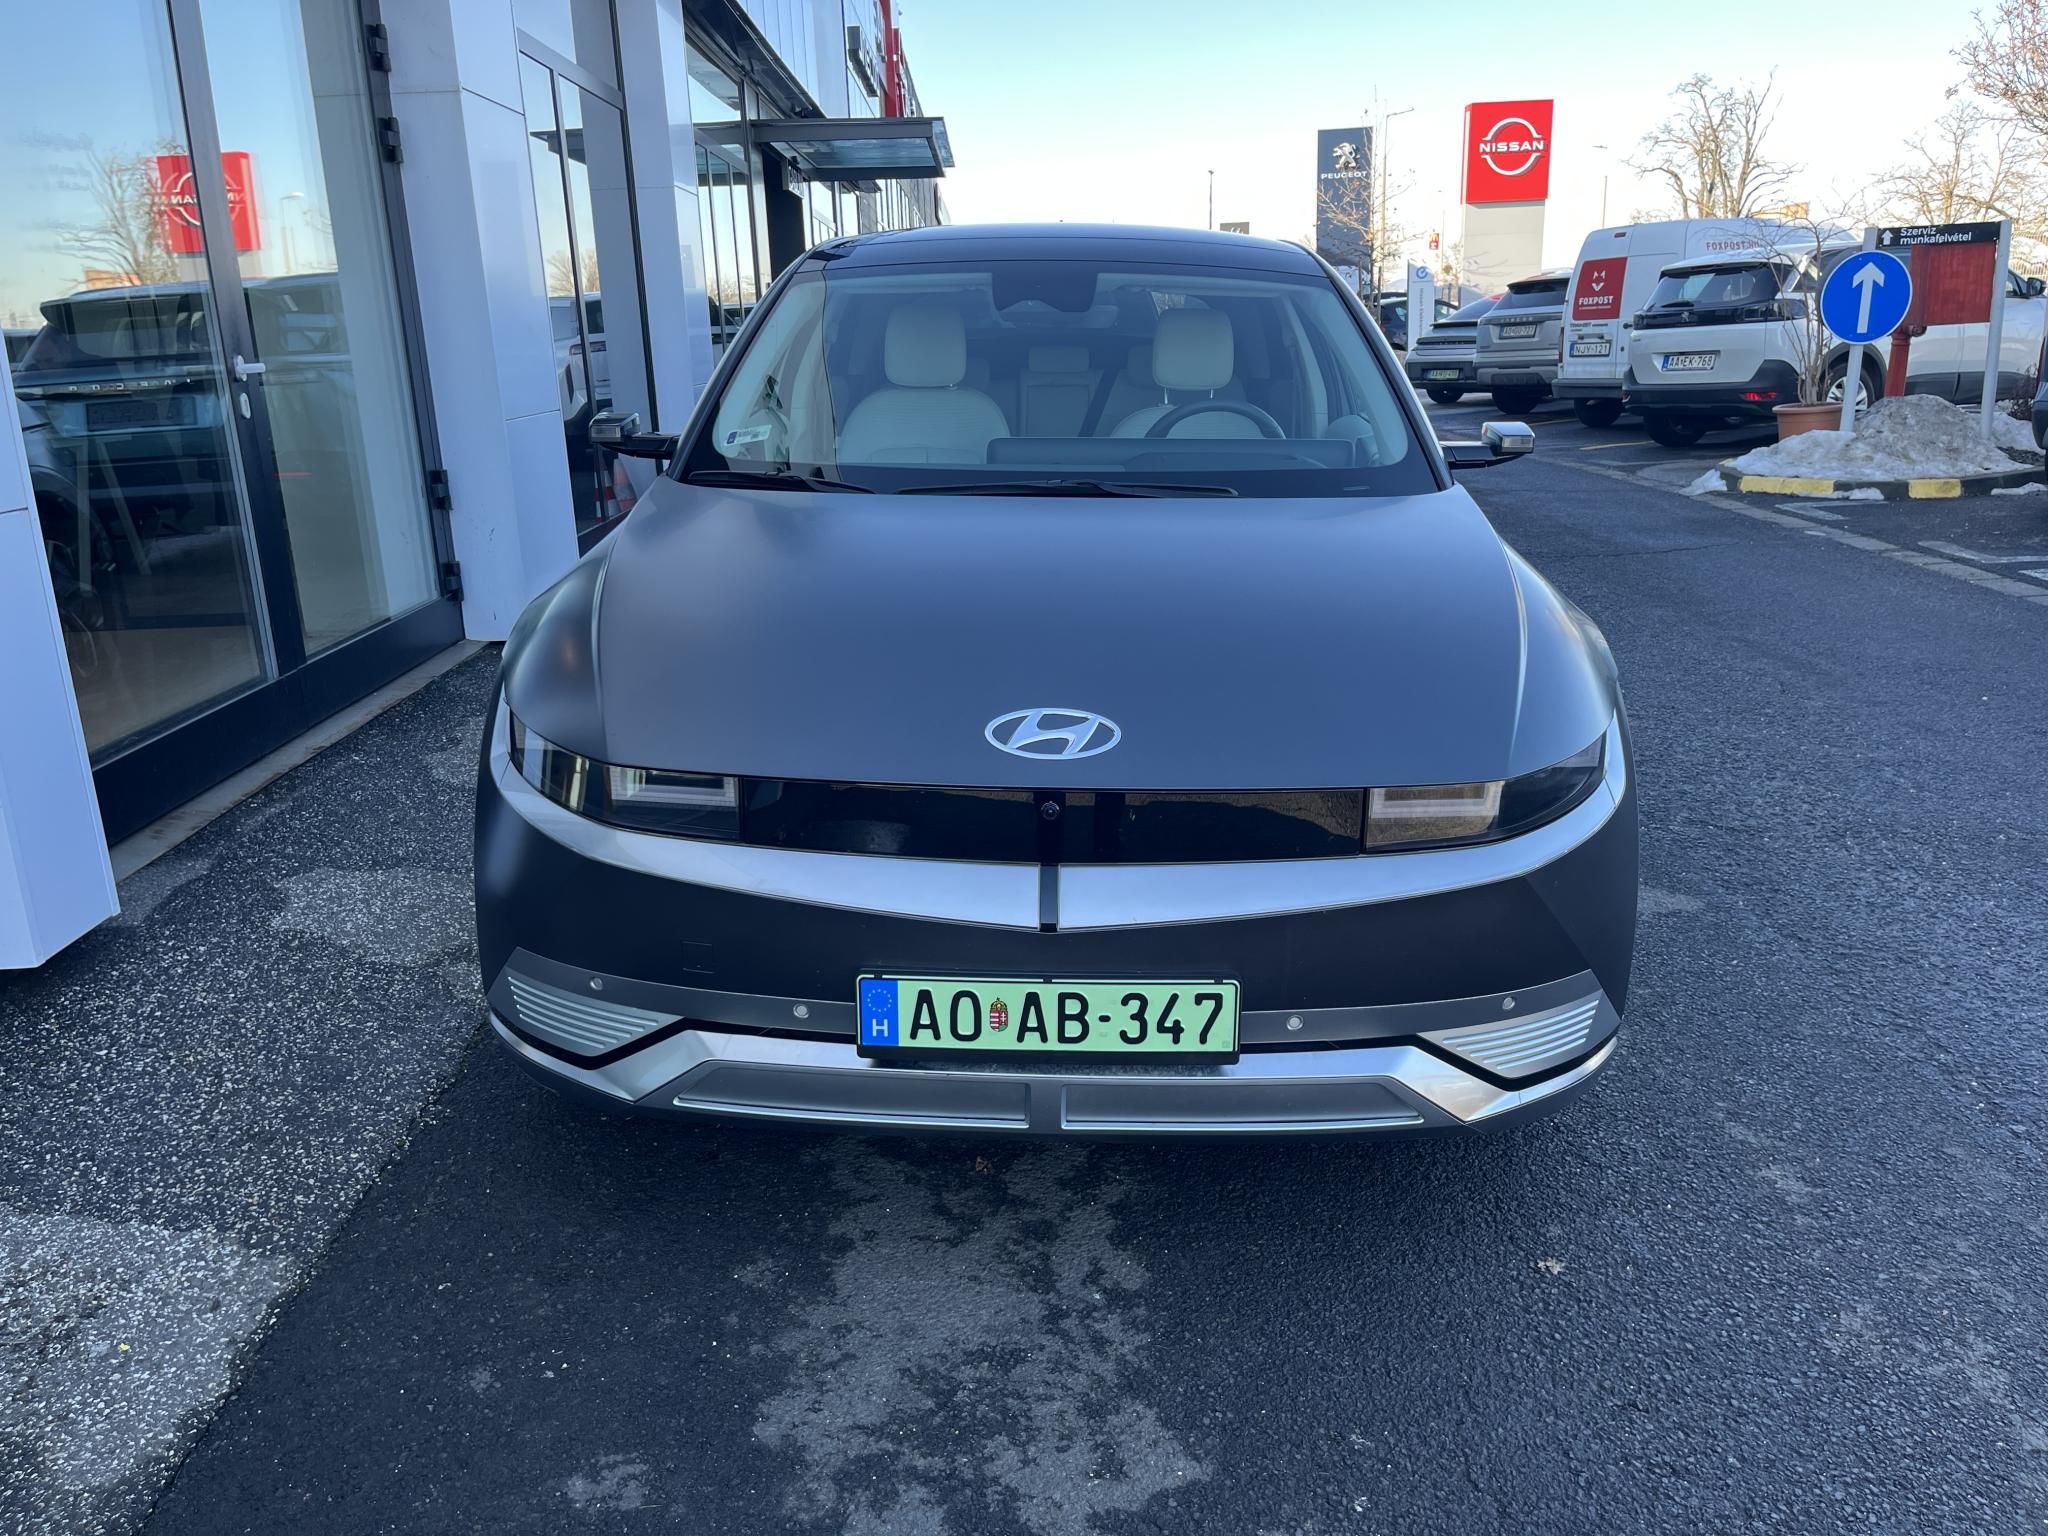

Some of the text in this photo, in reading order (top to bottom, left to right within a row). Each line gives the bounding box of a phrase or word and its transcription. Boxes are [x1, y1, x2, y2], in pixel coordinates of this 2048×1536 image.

[1479, 140, 1544, 153] NISSAN
[1321, 171, 1368, 180] PEUGEOT
[1900, 227, 1937, 236] Szerviz
[1900, 232, 1972, 245] munkafelvétel
[1579, 296, 1614, 305] FOXPOST
[872, 1018, 889, 1037] H
